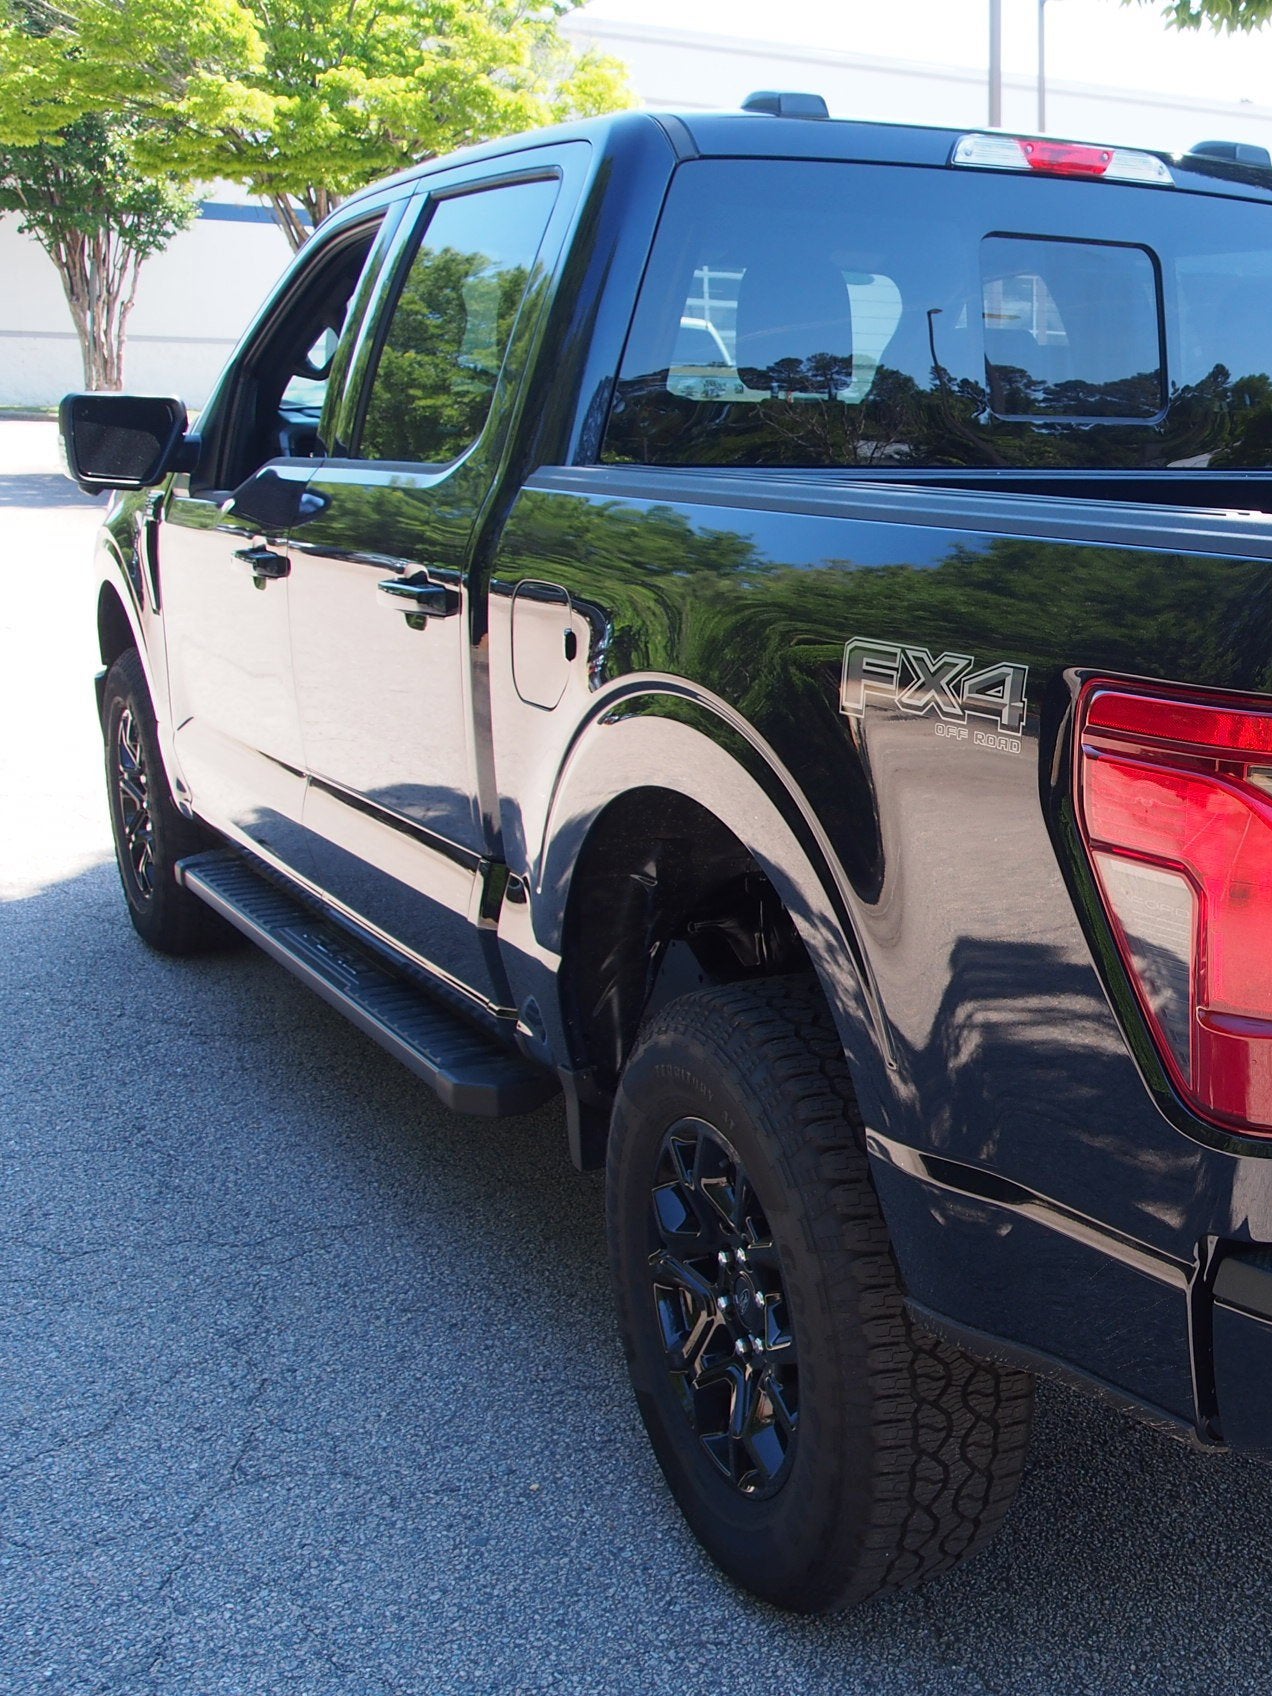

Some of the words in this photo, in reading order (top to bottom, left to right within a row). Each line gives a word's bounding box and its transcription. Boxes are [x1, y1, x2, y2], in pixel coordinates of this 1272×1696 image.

[839, 636, 1029, 736] FX4
[935, 723, 968, 741] OFF
[973, 731, 1022, 754] ROAD
